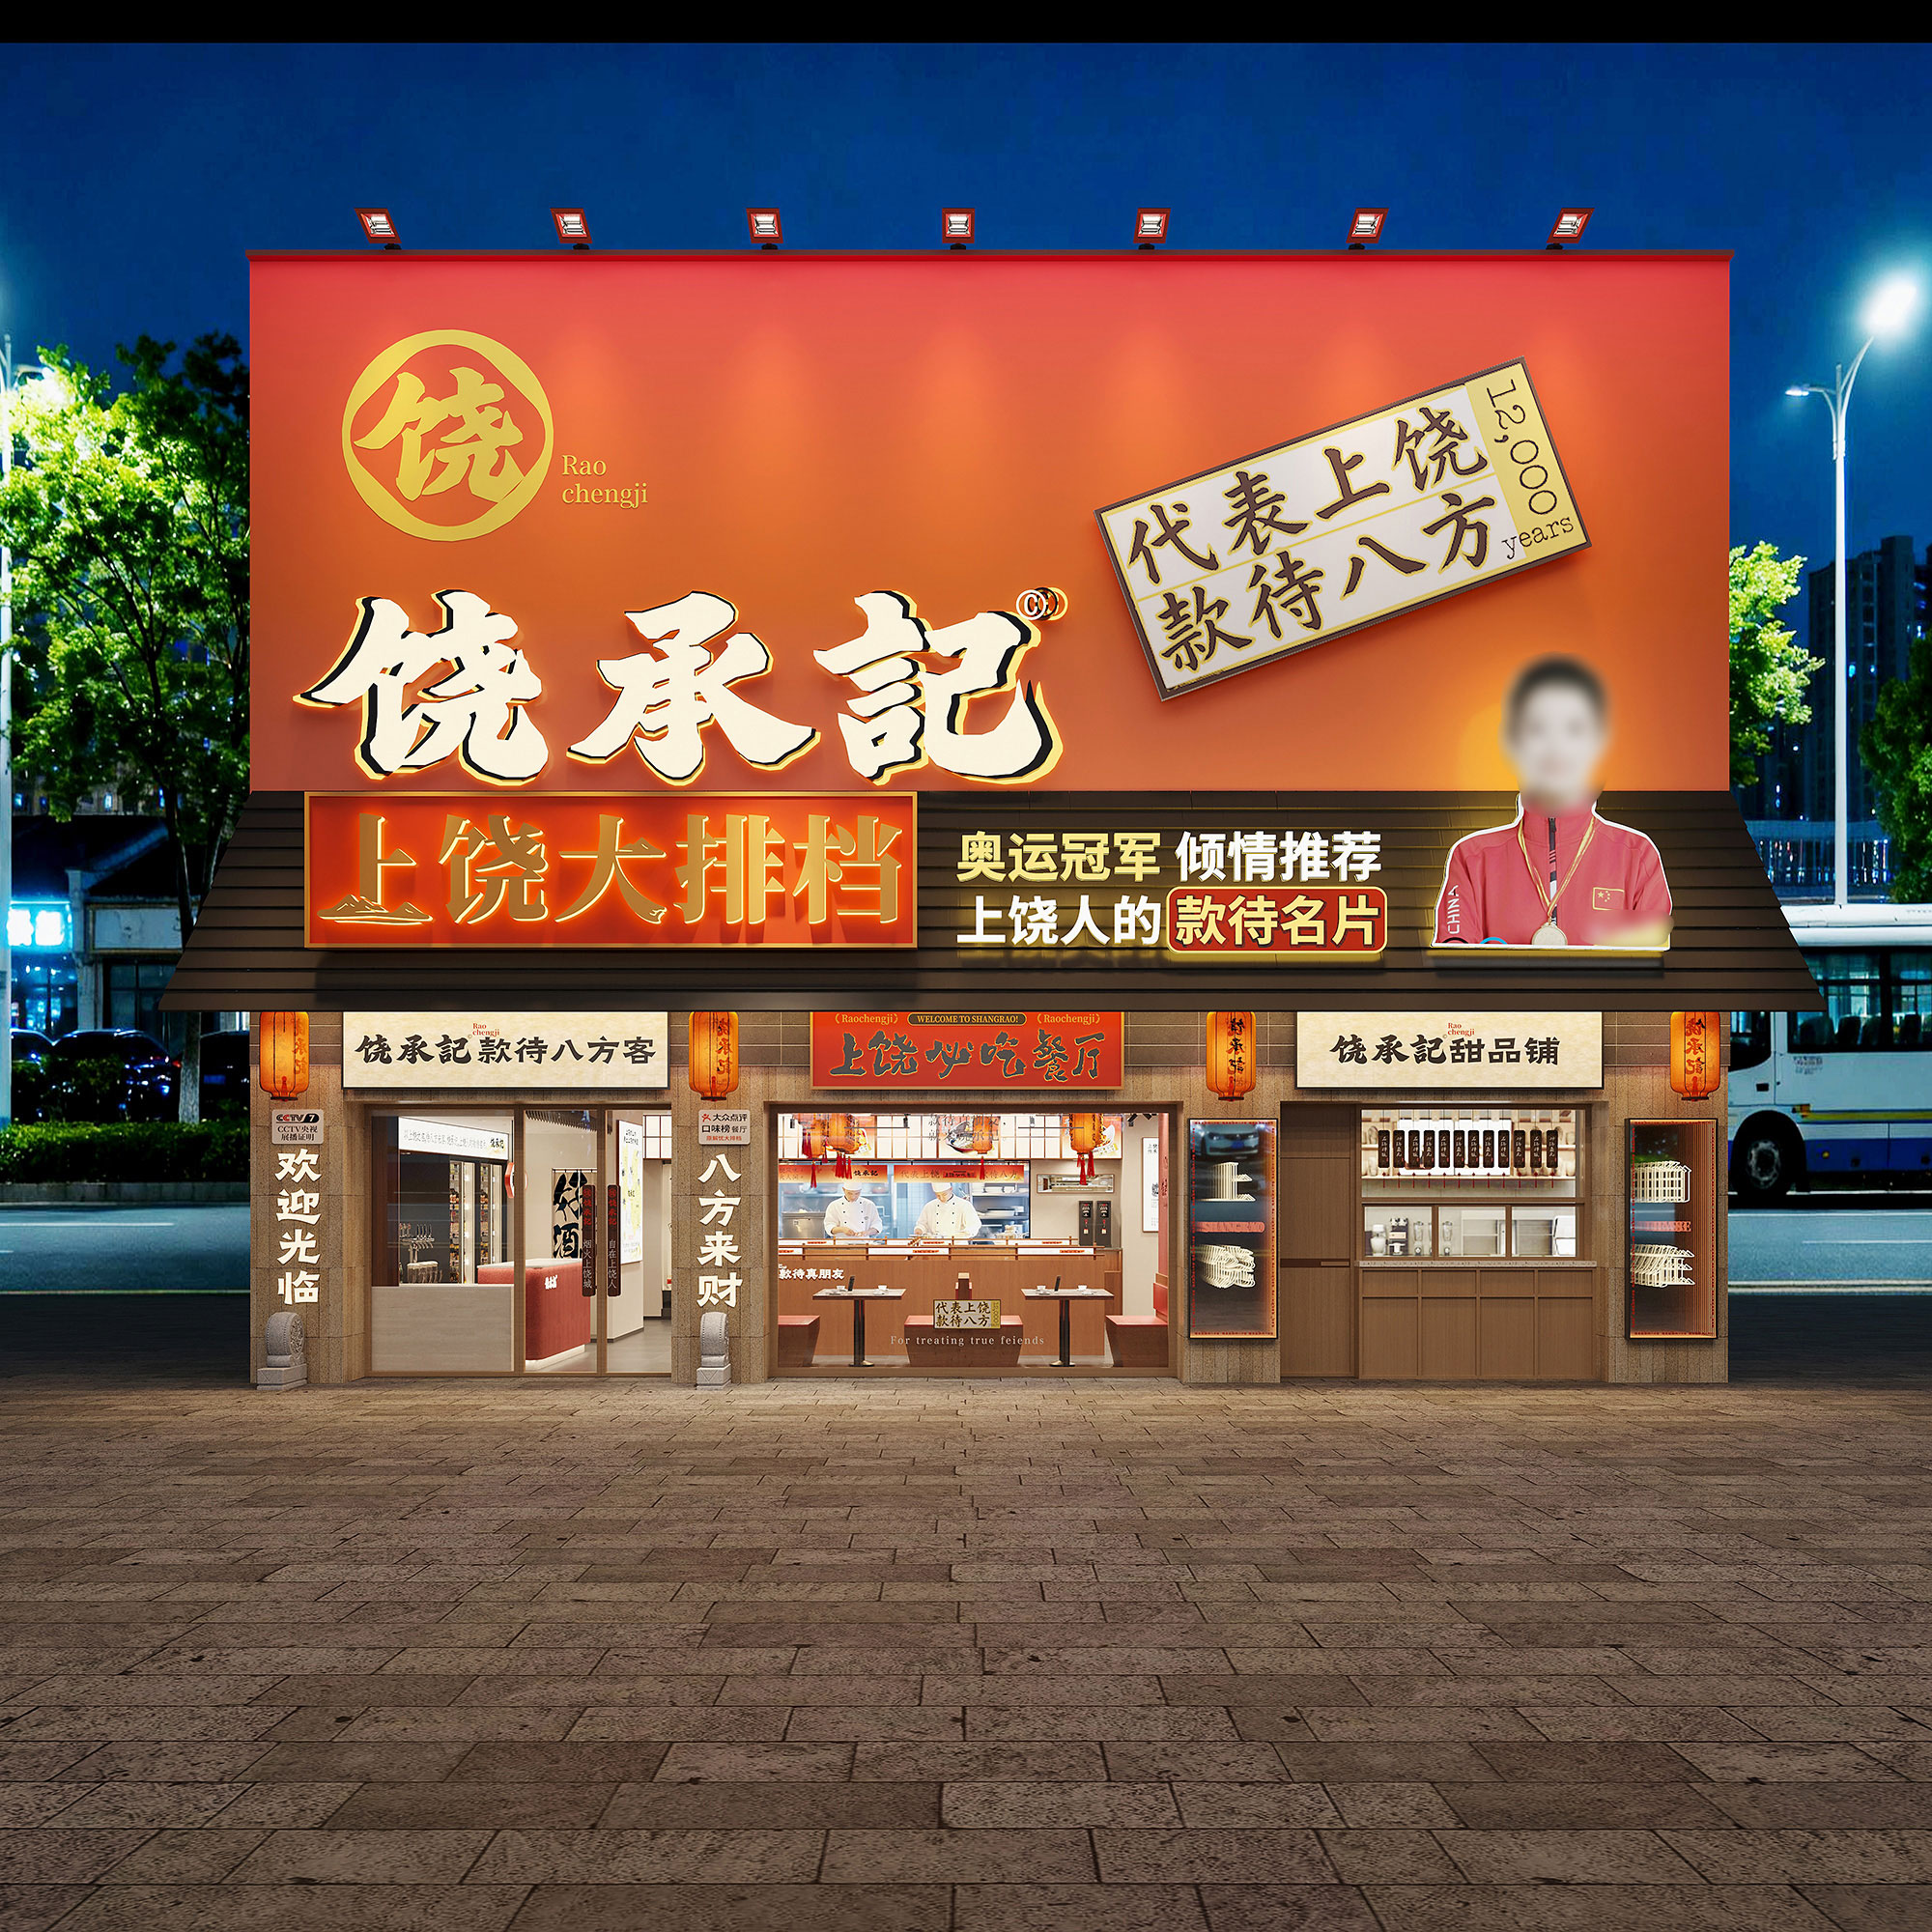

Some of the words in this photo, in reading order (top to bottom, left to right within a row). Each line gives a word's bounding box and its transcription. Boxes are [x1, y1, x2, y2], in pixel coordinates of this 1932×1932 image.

[354, 366, 526, 503] 饶
[561, 454, 607, 476] Rao
[561, 483, 649, 509] chengji
[1127, 407, 1489, 584] 代表上饶
[1501, 516, 1575, 559] years
[1157, 494, 1496, 671] 款待八方
[293, 588, 1064, 787] 饶承記
[317, 812, 902, 924] 上饶大排档
[956, 831, 1161, 883] 奥运冠军
[1175, 831, 1382, 883] 倾情推荐
[956, 895, 1161, 945] 上饶人的
[1175, 895, 1381, 946] 款待名片
[1447, 884, 1460, 935] CHINA
[275, 1149, 322, 1305] 欢迎光临
[696, 1153, 743, 1307] 八方来财
[779, 1268, 844, 1280] 款待真朋友
[936, 1301, 991, 1315] 代表上饶
[936, 1315, 990, 1328] 款待八方
[891, 1336, 910, 1345] For
[916, 1335, 964, 1347] treating
[970, 1336, 995, 1345] true
